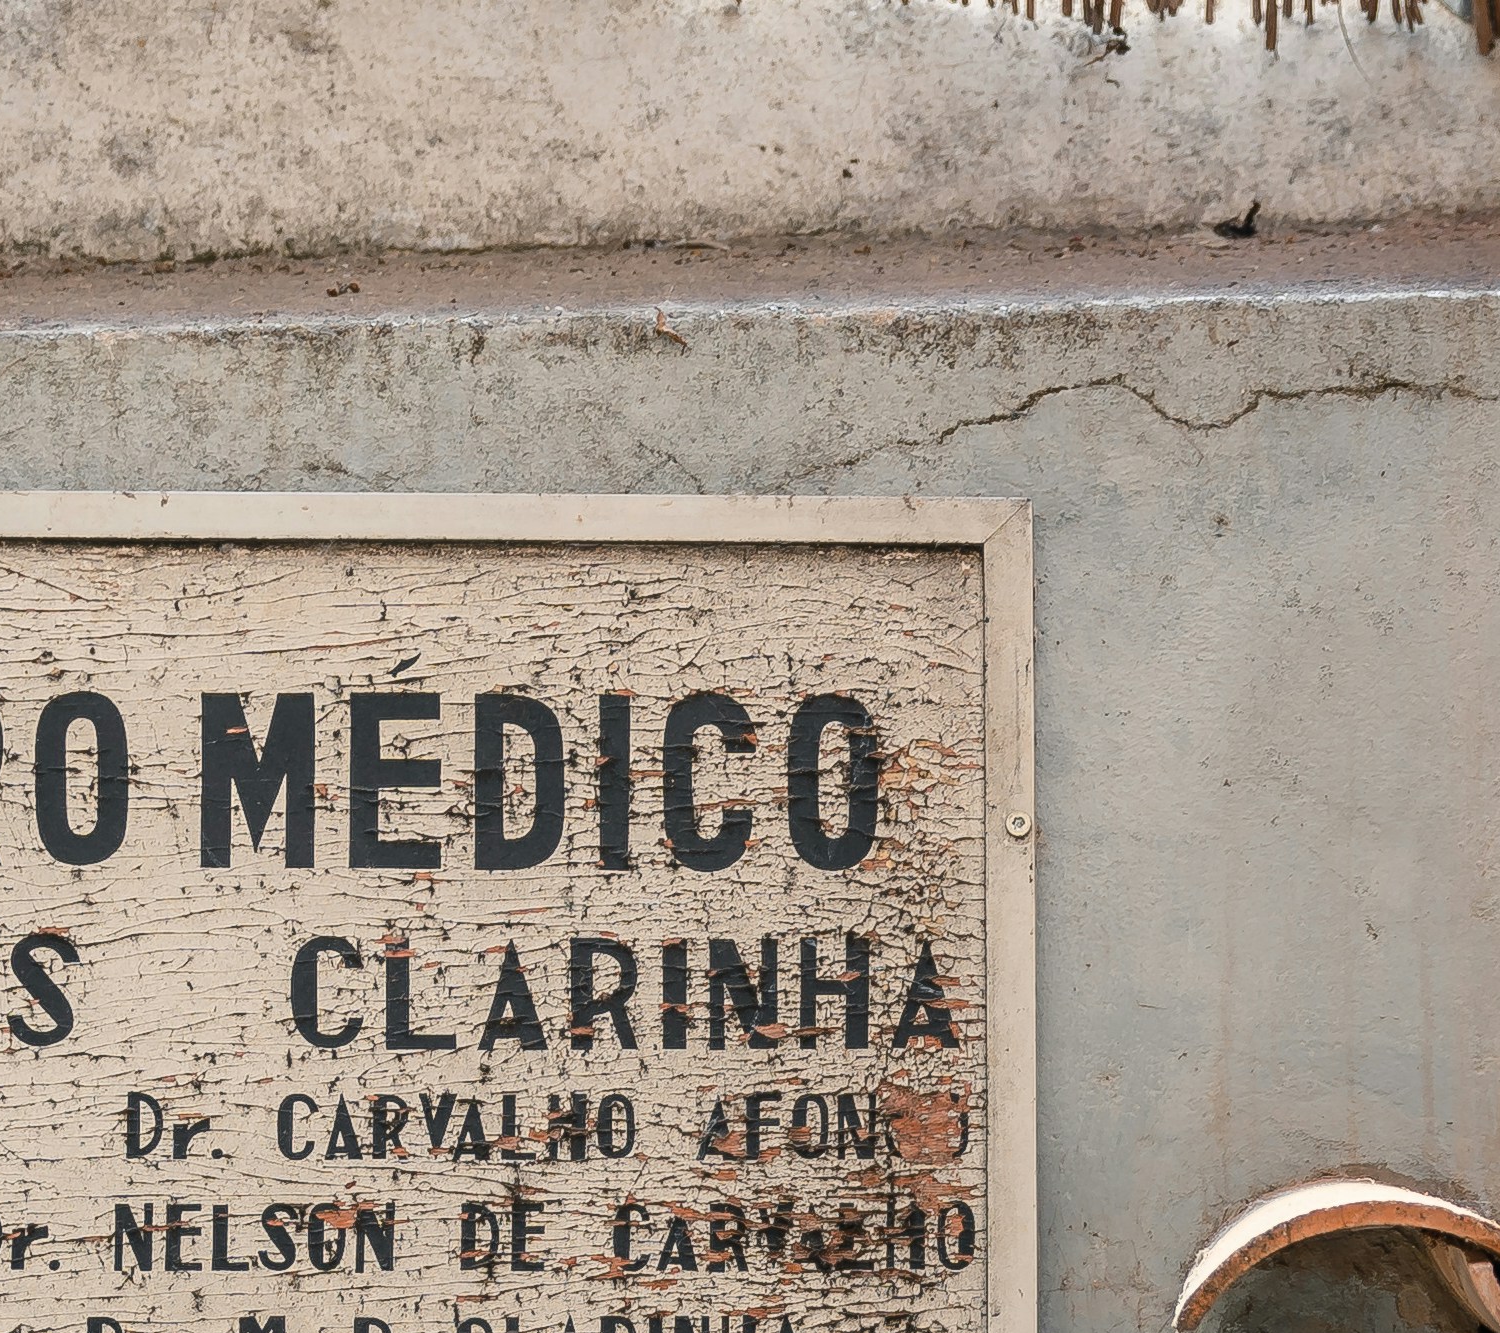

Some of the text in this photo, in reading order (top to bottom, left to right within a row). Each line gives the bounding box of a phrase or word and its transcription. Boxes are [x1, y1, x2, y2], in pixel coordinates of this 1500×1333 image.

[290, 935, 960, 1051] CLARINHA
[126, 1091, 968, 1161] Dr. CARVALHO AFON
[114, 1203, 395, 1273] NELSON
[461, 1201, 545, 1271] DE
